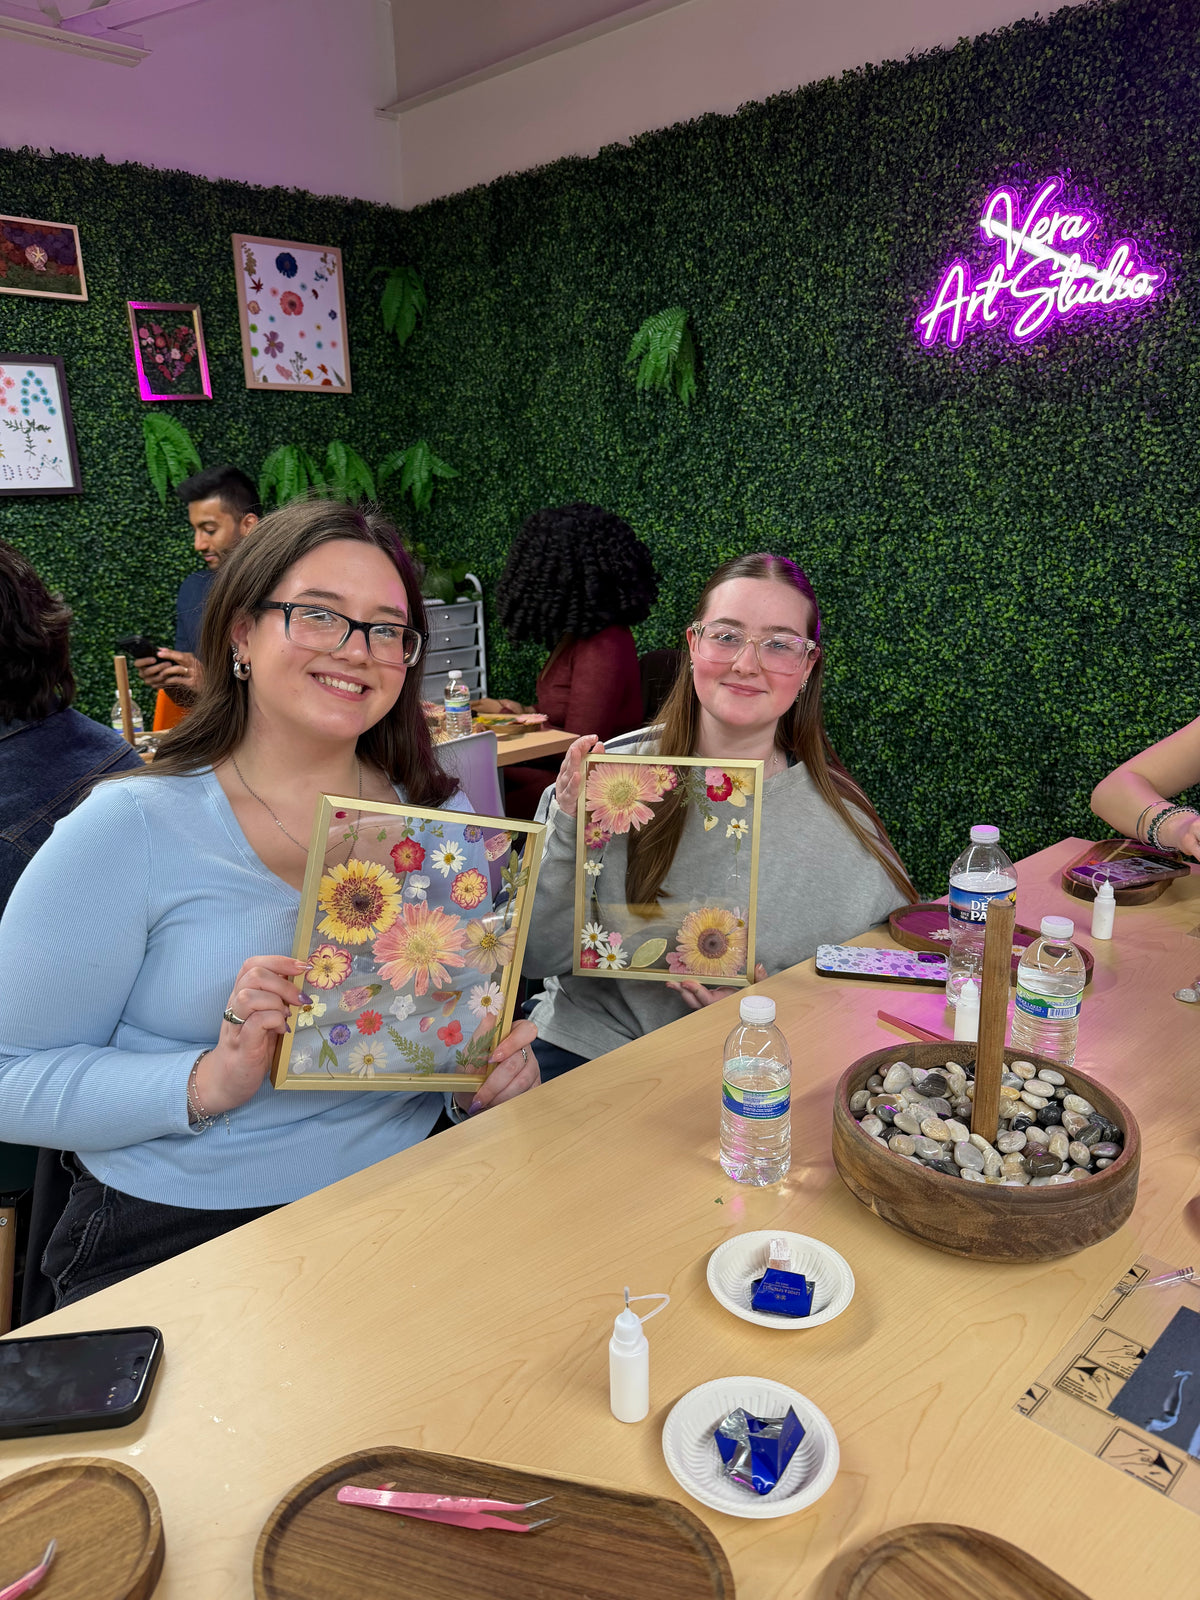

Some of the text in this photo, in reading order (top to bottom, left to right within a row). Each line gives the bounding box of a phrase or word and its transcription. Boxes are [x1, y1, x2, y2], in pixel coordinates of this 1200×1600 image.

[983, 183, 1091, 271] Vera
[919, 244, 1159, 342] Art Studio
[970, 910, 987, 922] PA
[971, 899, 988, 911] DE
